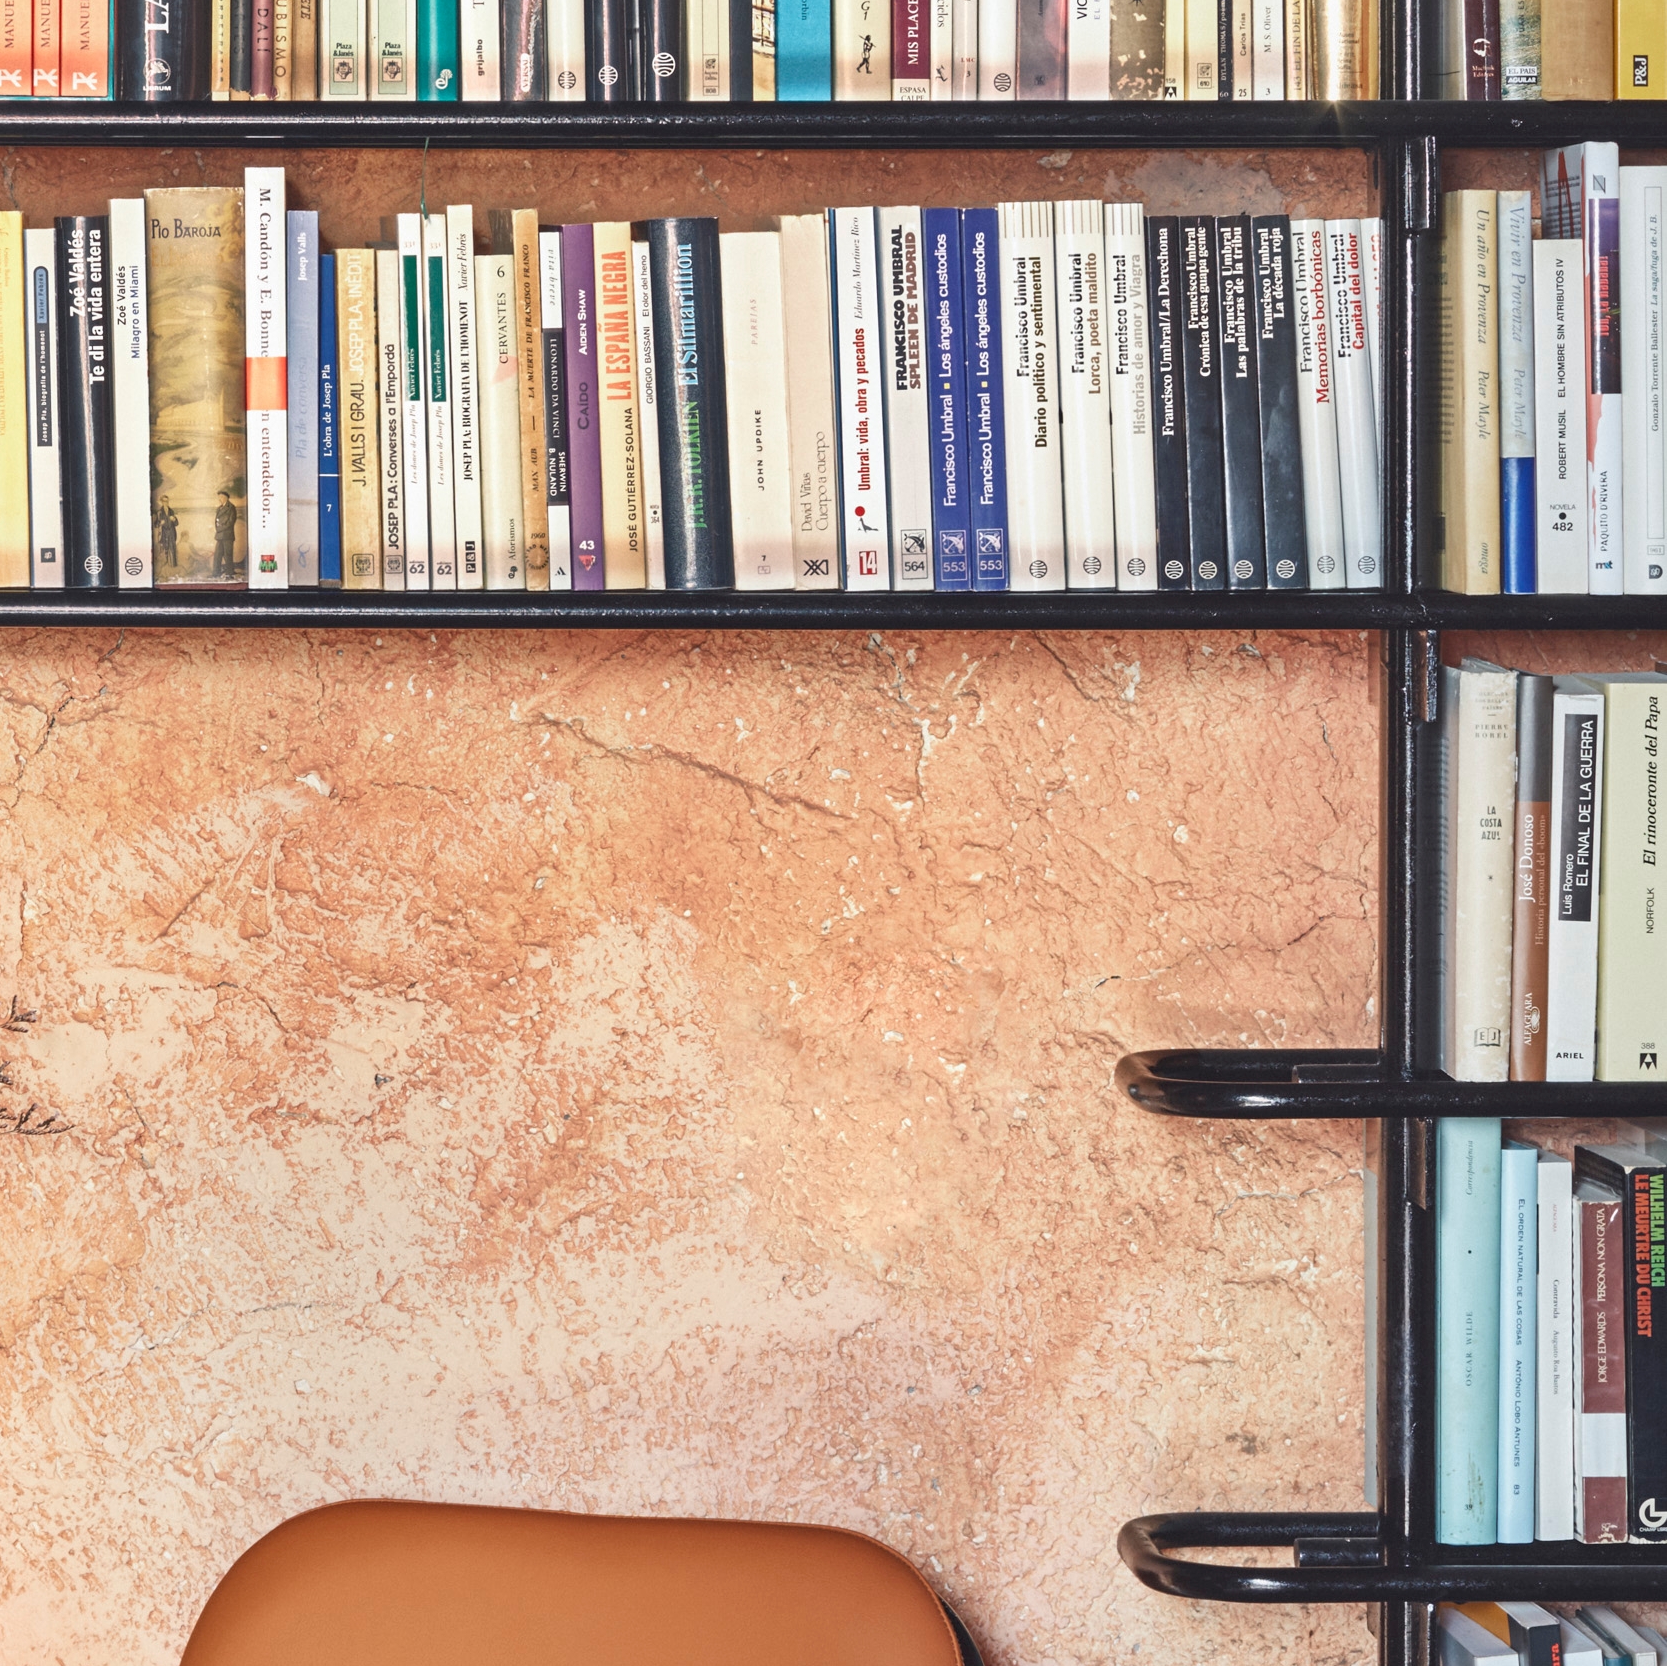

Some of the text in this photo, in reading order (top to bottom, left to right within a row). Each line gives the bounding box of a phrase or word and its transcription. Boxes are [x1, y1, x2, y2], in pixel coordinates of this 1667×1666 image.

[907, 42, 919, 64] MIS
[1634, 57, 1647, 85] P&J
[67, 229, 86, 317] Zoé Valdés
[86, 229, 105, 384] Te di la vida entera
[891, 224, 908, 391] FRANCISCO UMBRAL
[905, 231, 921, 389] SPLEEN DE MADRID
[934, 234, 953, 377] Los ángeles custodios
[597, 251, 632, 400] LA ESPAÑA NEGRA
[853, 328, 869, 374] pecados
[855, 388, 868, 413] obra
[856, 417, 869, 444] vida,
[857, 448, 871, 491] Umbral:
[940, 394, 956, 506] Francisco Umbral
[579, 540, 595, 550] 43
[1552, 522, 1573, 531] 482
[905, 561, 926, 571] 564
[944, 561, 966, 574] 553
[1576, 720, 1594, 887] EL FINAL DE LA GUERRA
[1643, 696, 1660, 866] El rinoceronte del Papa
[1518, 813, 1536, 903] José Donoso
[1562, 854, 1574, 914] Luis Romero
[1646, 888, 1654, 934] NORFOLK
[1635, 1174, 1652, 1338] LE MEURTRE DU CHRIST
[1649, 1174, 1666, 1287] WILHELM REICH
